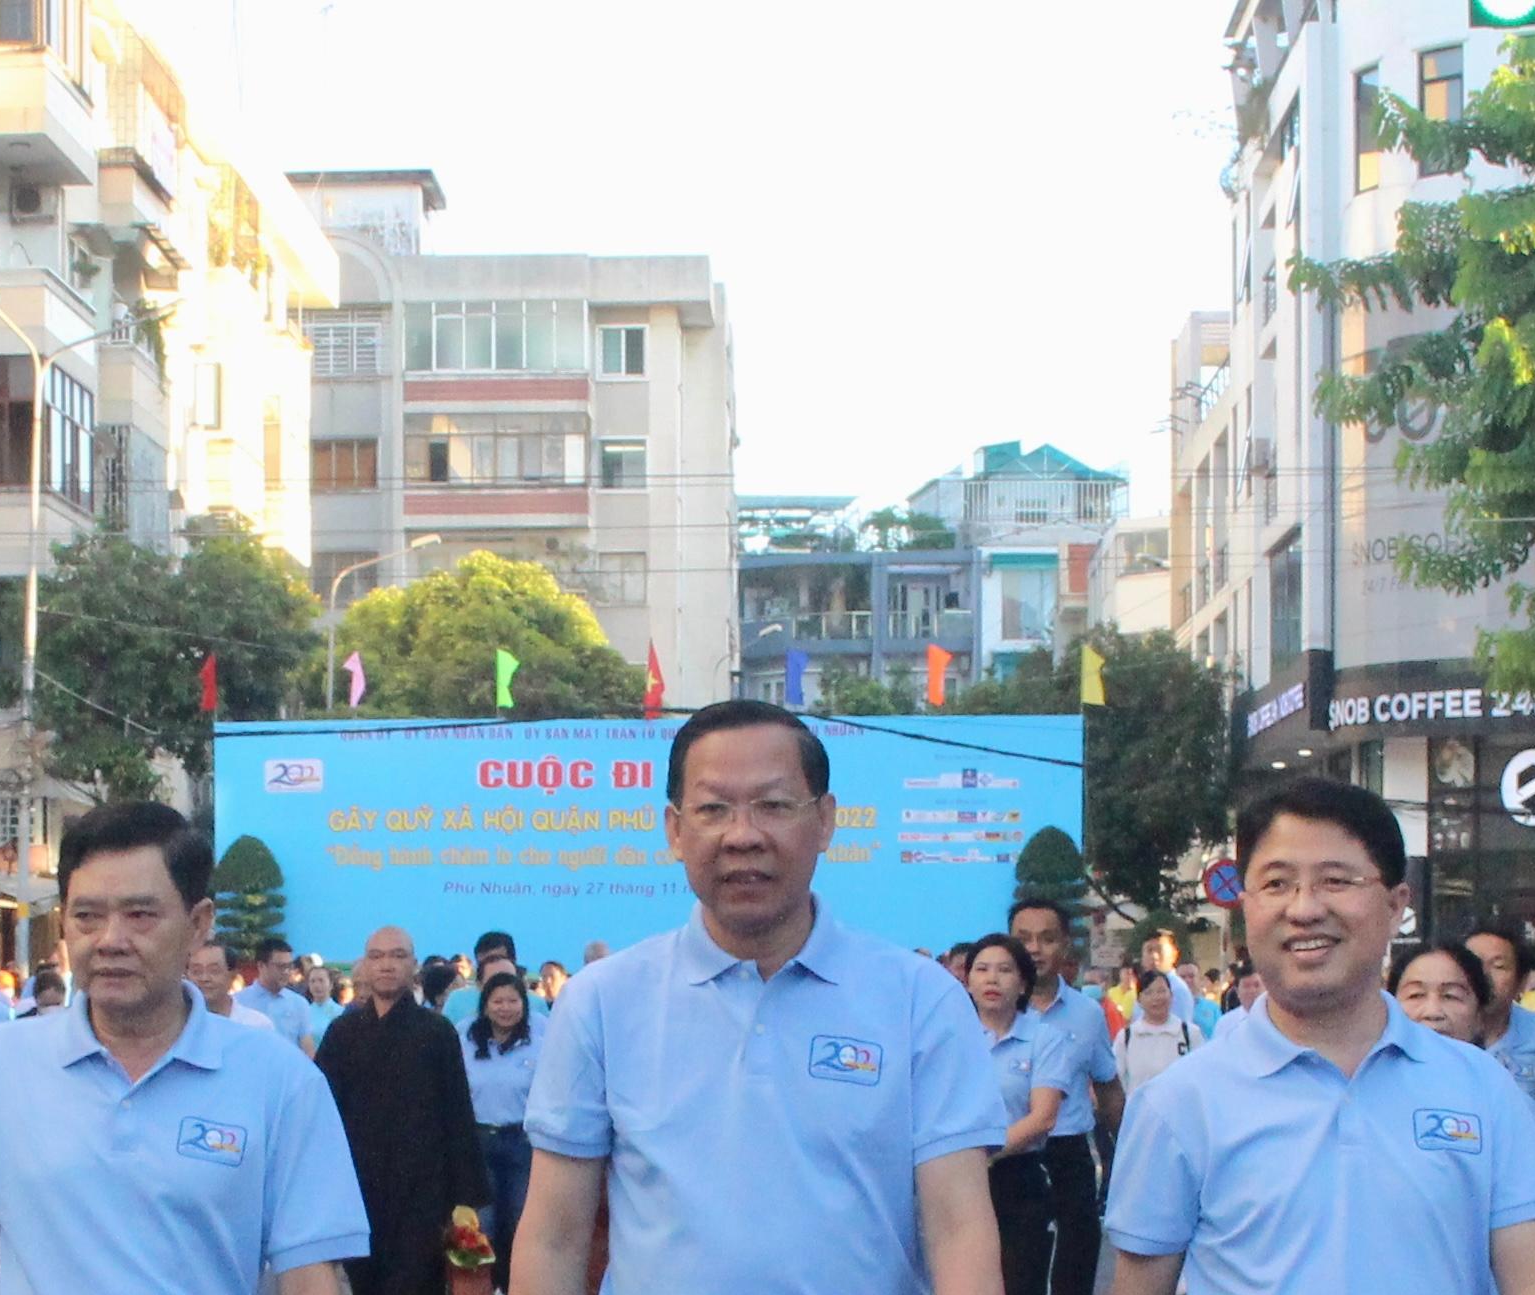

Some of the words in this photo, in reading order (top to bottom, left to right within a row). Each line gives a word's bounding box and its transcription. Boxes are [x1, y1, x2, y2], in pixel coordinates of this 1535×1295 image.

[1374, 688, 1483, 723] COFFEE
[477, 755, 595, 795] CUỘC
[612, 760, 653, 789] ĐI
[328, 804, 377, 833] GÂY
[385, 804, 433, 833] QUỸ
[442, 805, 474, 832] XÃ
[483, 802, 524, 835] HỘI
[531, 802, 600, 836] QUẬN
[833, 804, 878, 829] 022
[585, 882, 605, 895] 27
[662, 882, 677, 895] 11
